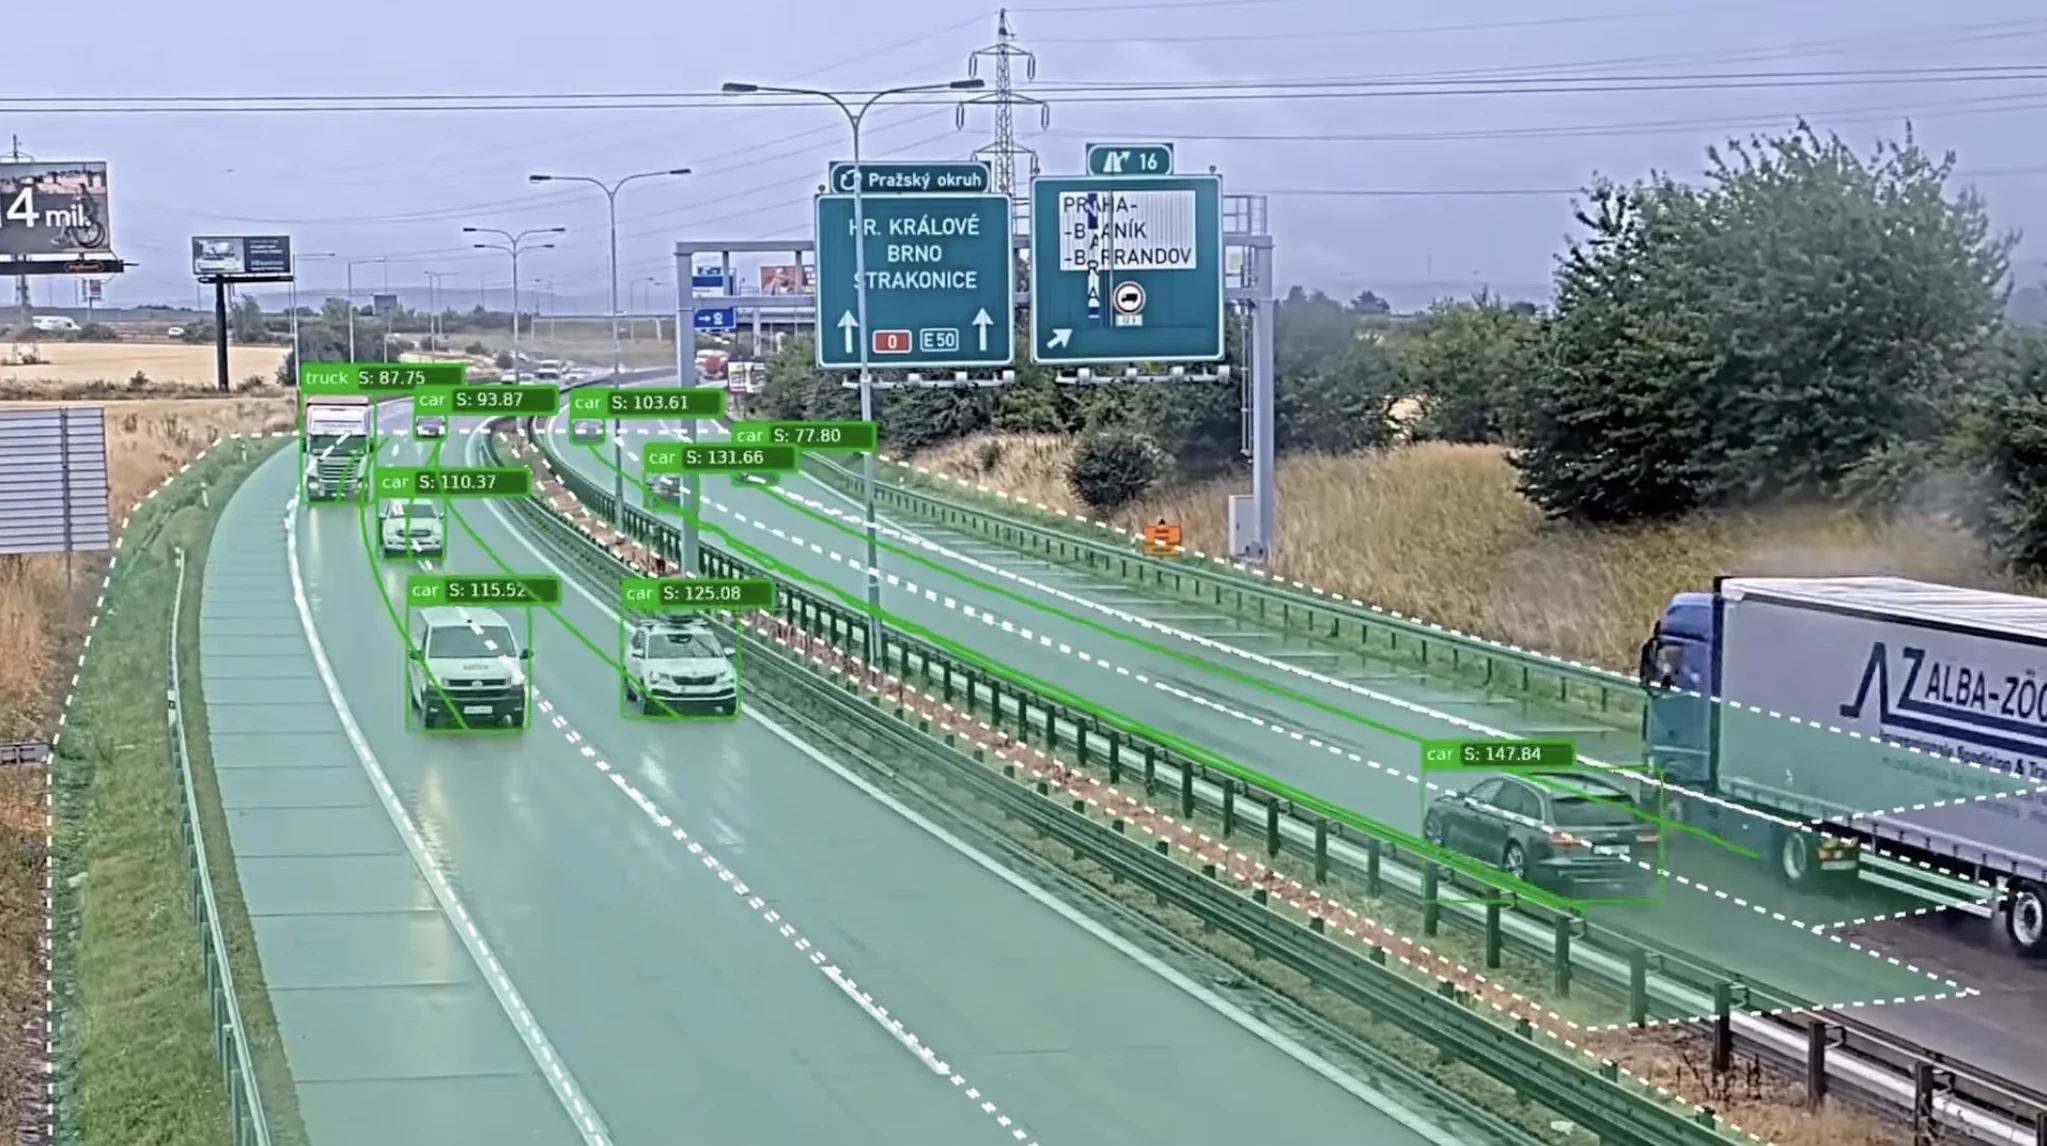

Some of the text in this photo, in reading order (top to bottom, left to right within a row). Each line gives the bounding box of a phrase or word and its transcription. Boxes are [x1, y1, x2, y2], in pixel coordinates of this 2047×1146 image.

[1139, 153, 1158, 170] 16
[868, 172, 982, 190] Pražský okruh
[0, 187, 92, 228] 4 mil.
[889, 214, 980, 236] KRÁLOVÉ
[887, 244, 942, 262] BRNO
[853, 271, 978, 289] STRAKONICE
[887, 335, 898, 349] 0
